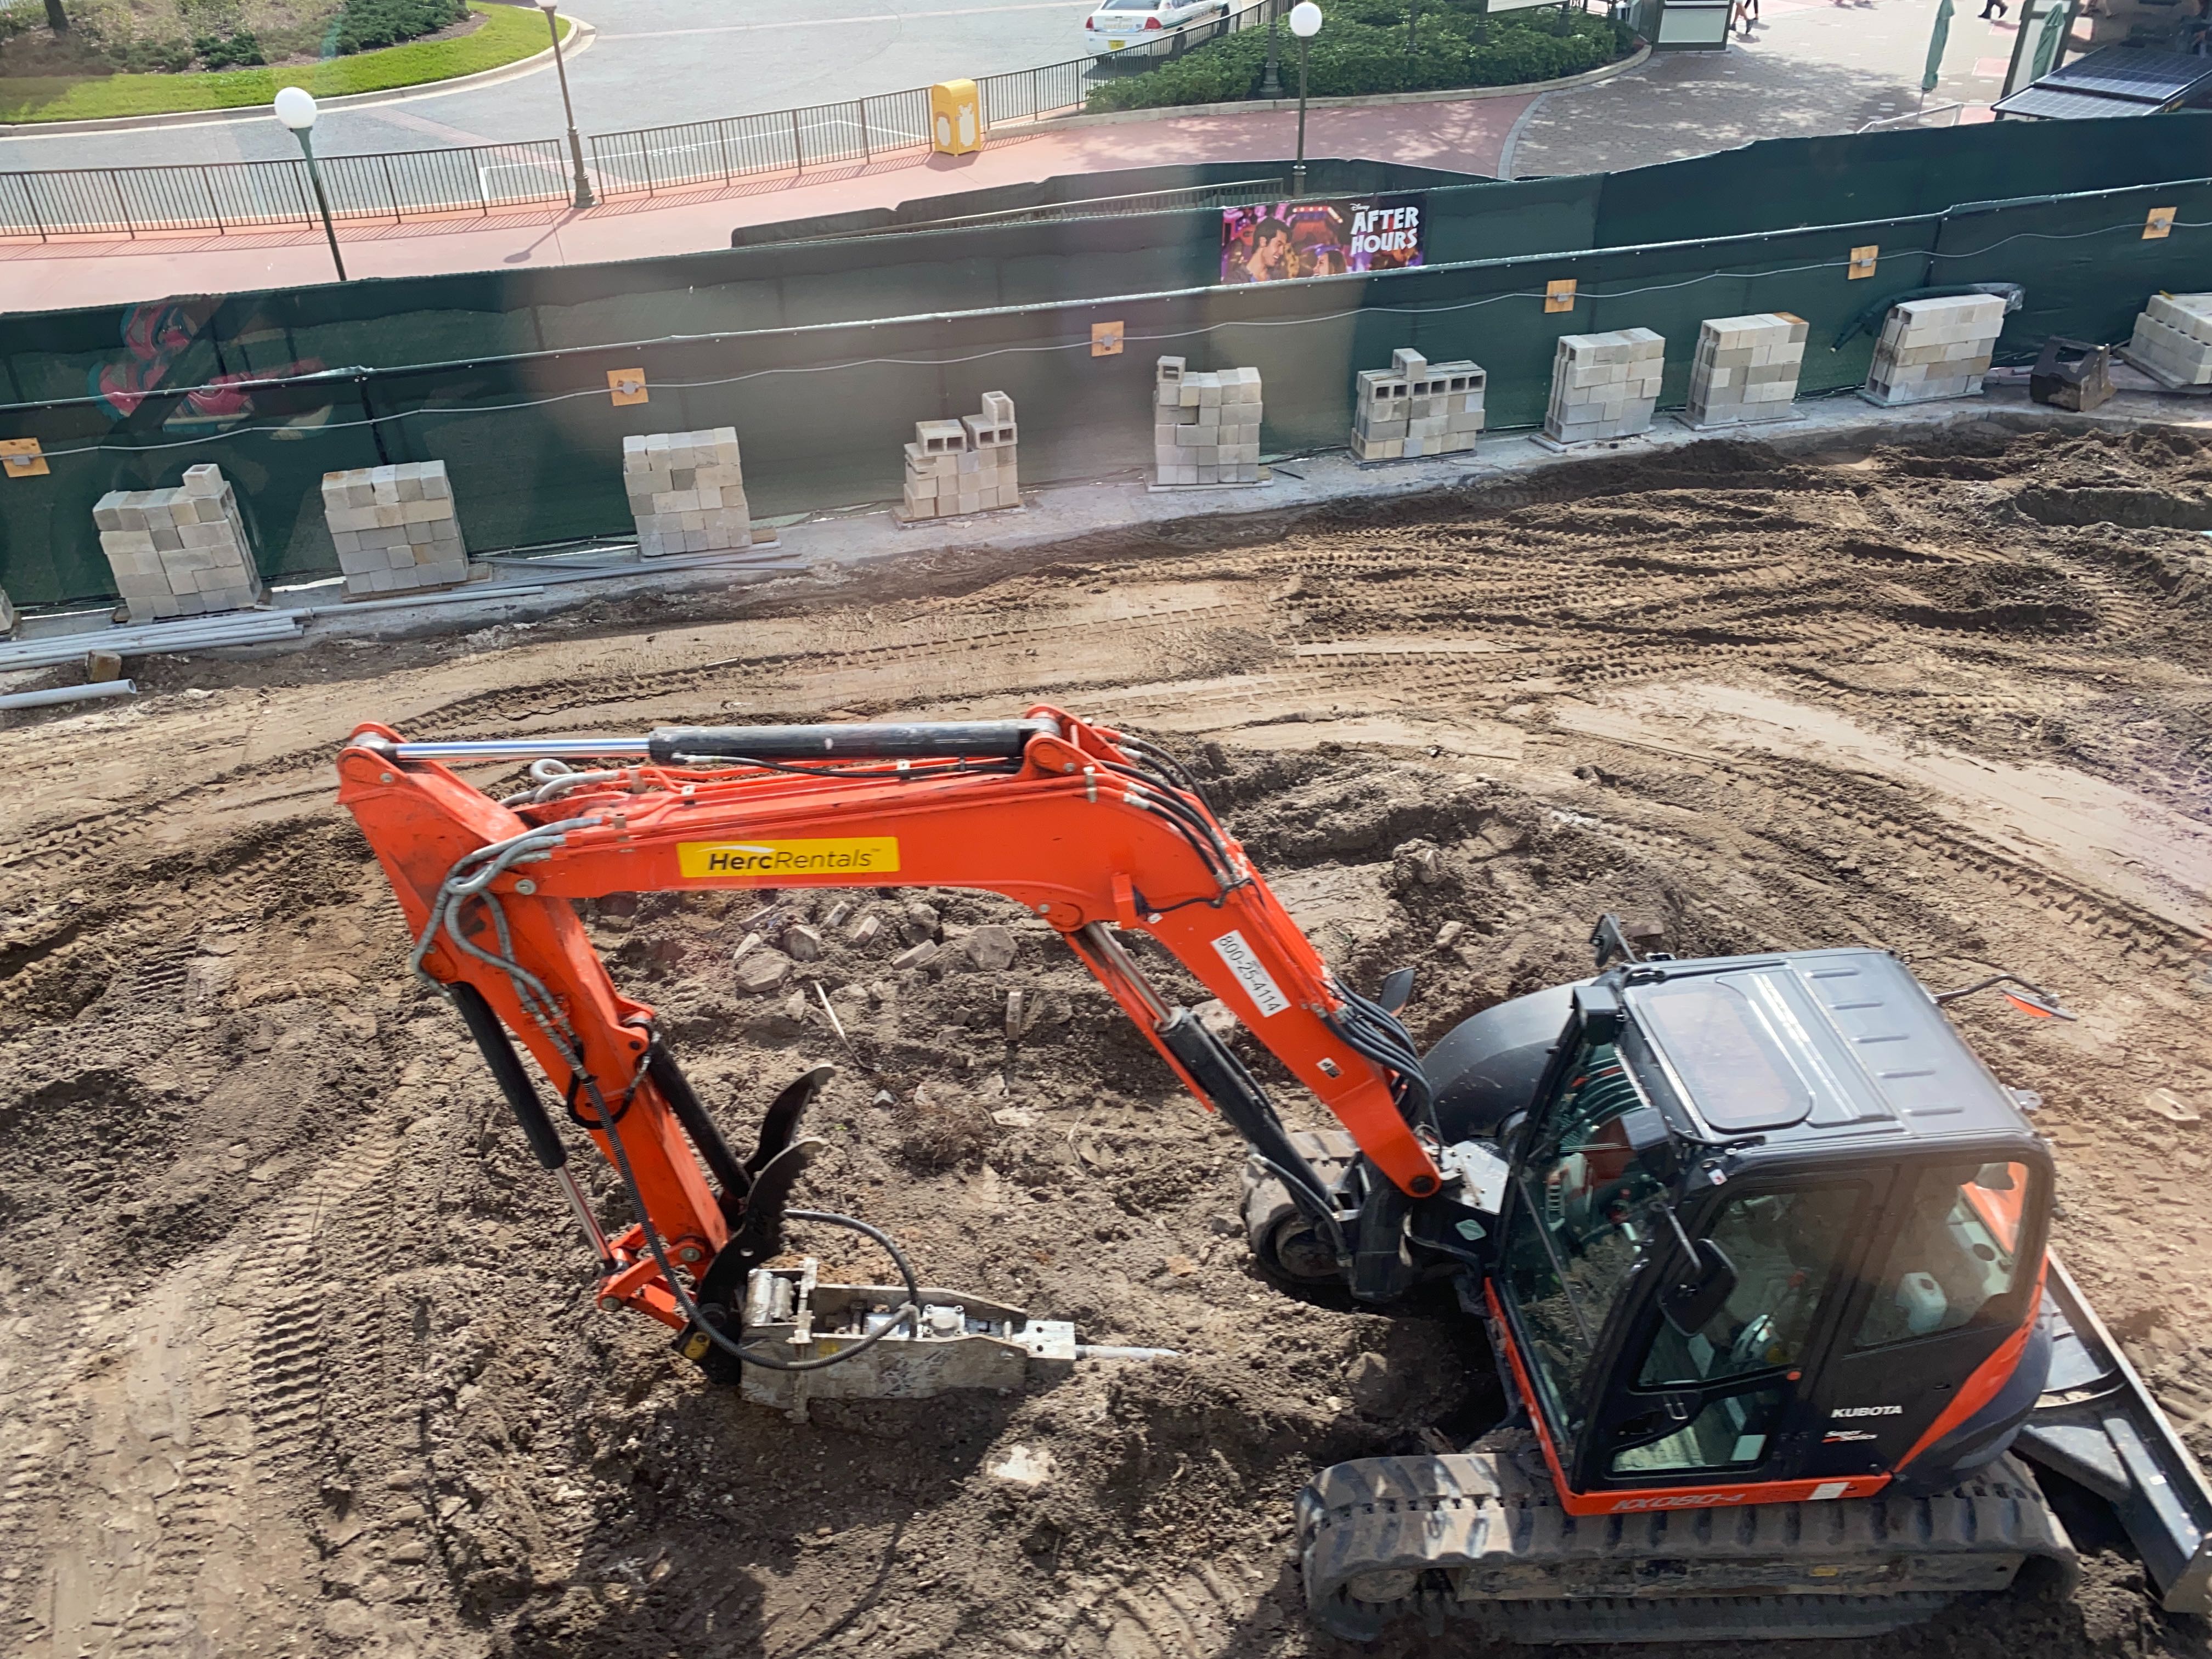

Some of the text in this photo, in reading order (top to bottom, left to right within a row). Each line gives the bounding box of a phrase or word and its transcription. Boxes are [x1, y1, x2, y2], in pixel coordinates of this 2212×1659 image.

[1350, 206, 1419, 235] AFTER
[1350, 228, 1418, 257] HOURS
[1218, 935, 1282, 1011] 800-25-4114
[1831, 1405, 1903, 1418] KUBOTA
[1611, 1493, 1746, 1510] KX080-4
